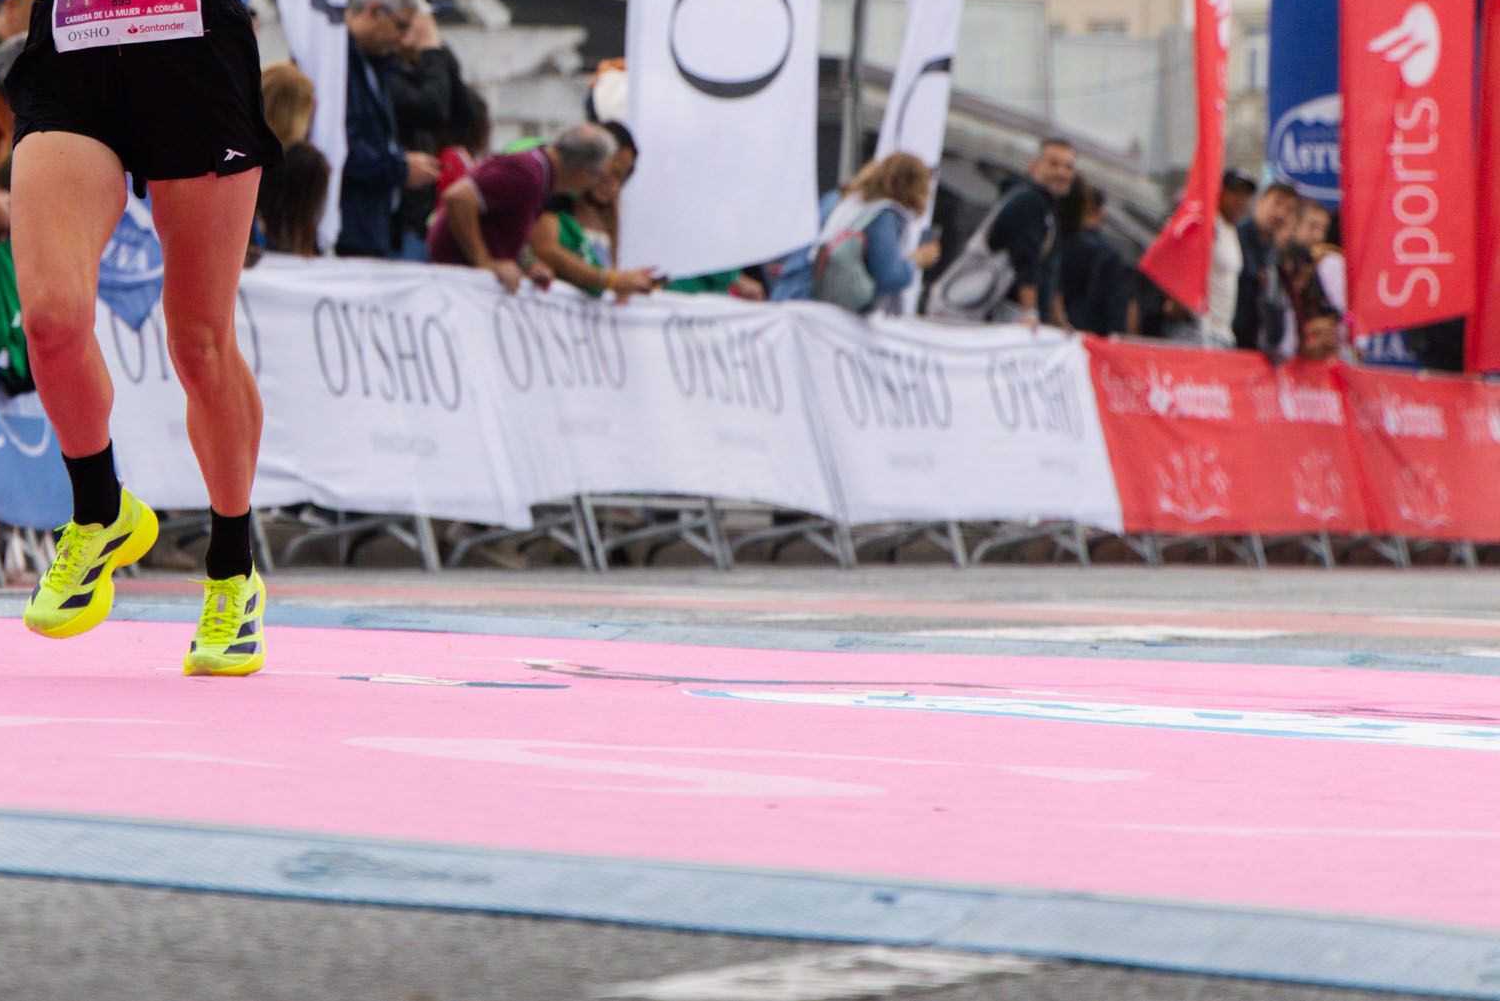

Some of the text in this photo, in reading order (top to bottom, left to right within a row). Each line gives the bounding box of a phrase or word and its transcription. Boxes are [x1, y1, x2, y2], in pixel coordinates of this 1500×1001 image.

[65, 11, 92, 25] CARRERA
[94, 11, 103, 20] DE
[105, 9, 115, 18] LA
[116, 7, 140, 17] MUJER
[146, 6, 153, 14] A
[154, 3, 185, 14] CORUÑA
[68, 22, 185, 42] OYSHO Santander
[1378, 96, 1454, 308] Sports
[311, 296, 463, 413] OYSHO
